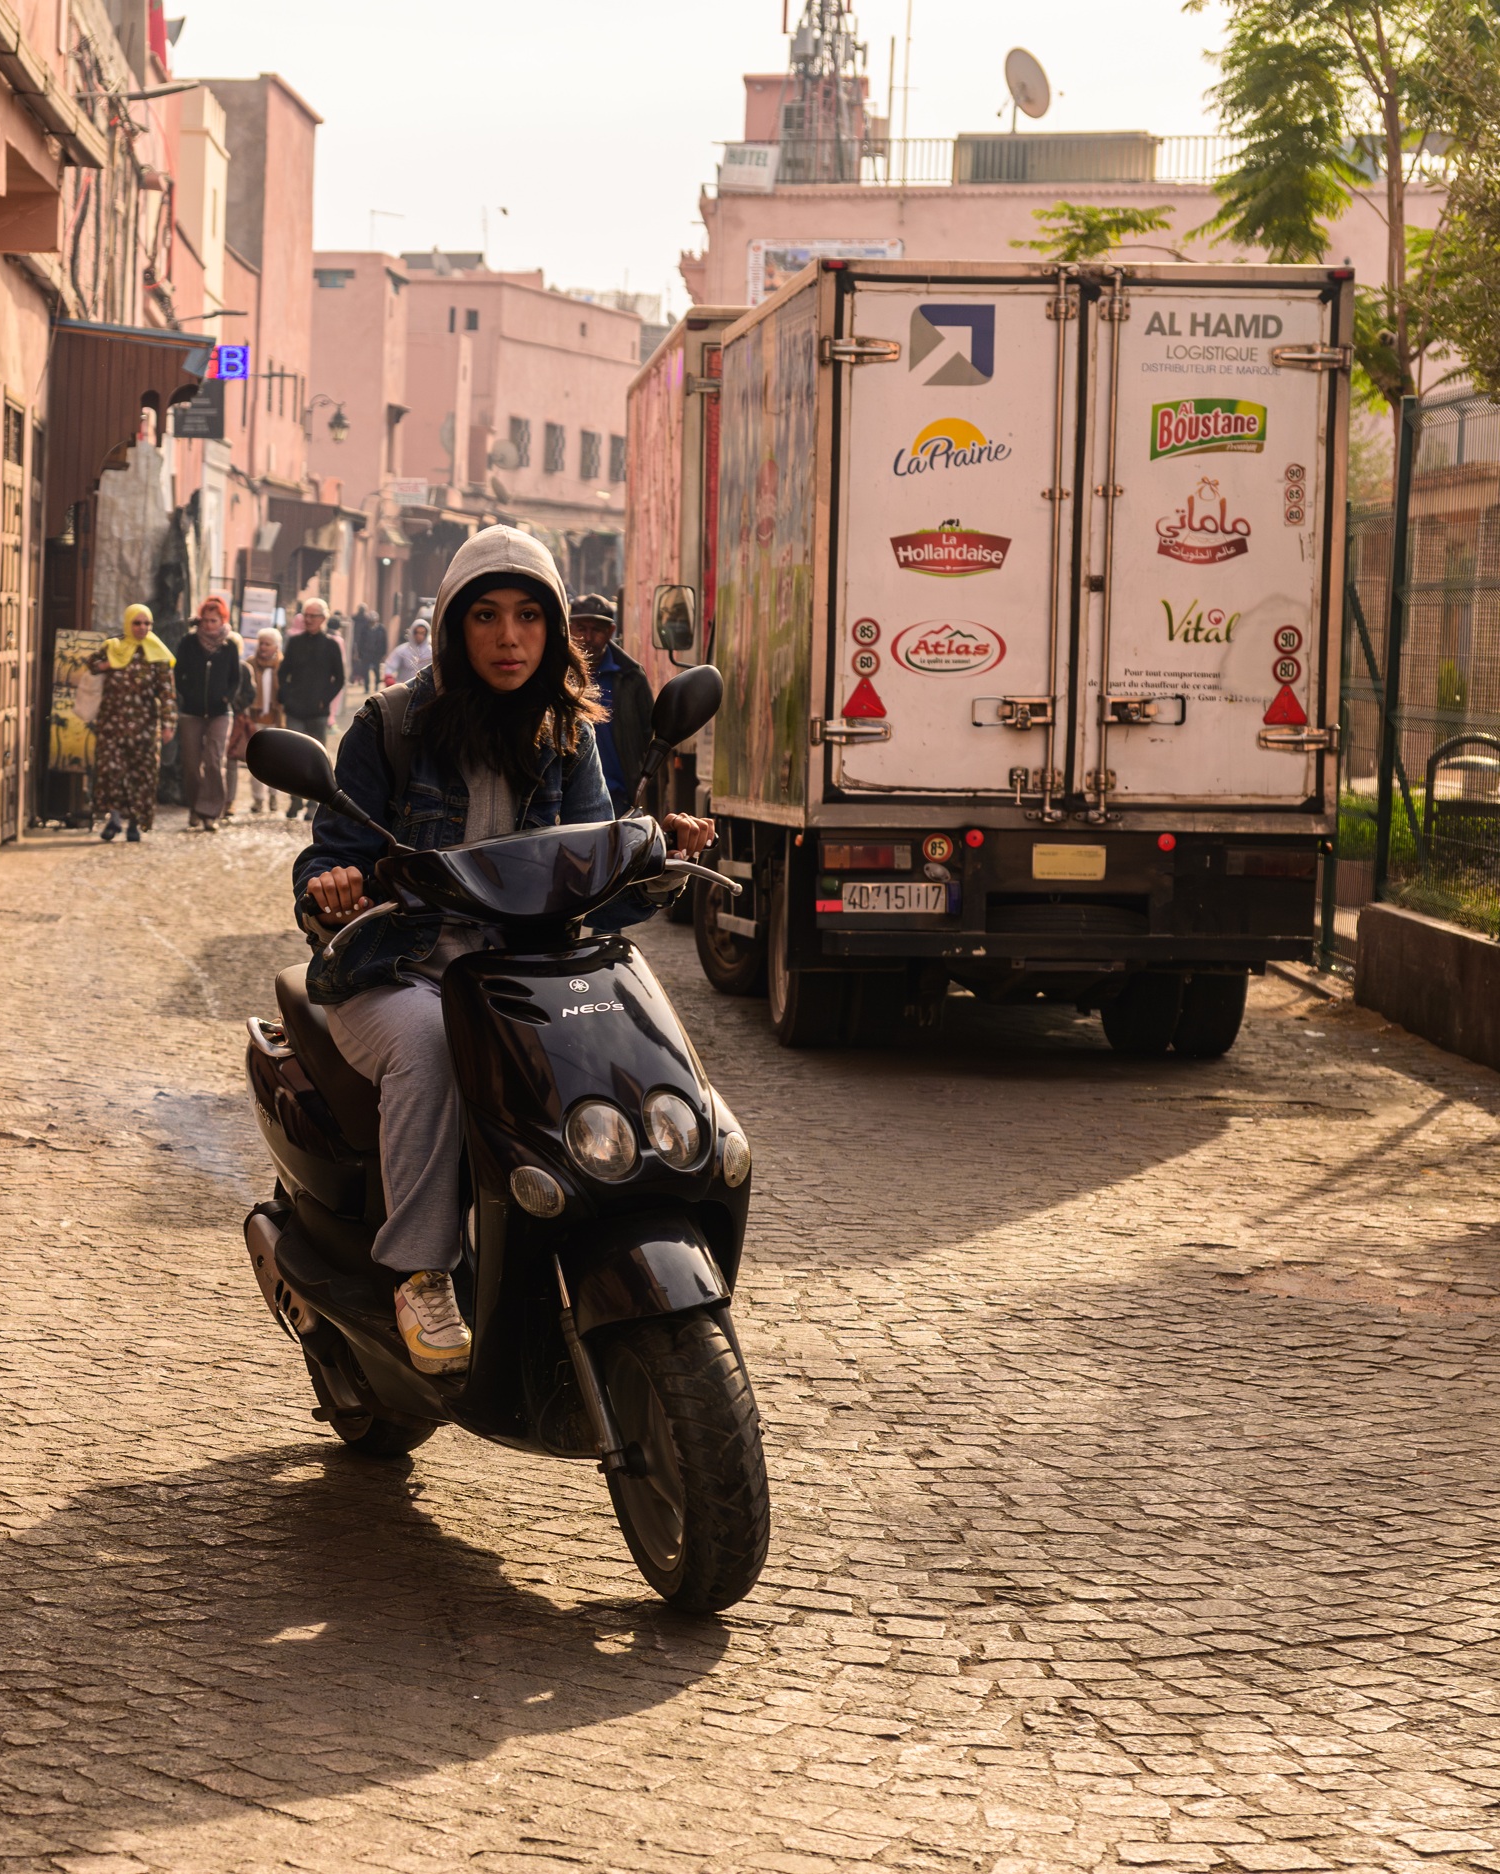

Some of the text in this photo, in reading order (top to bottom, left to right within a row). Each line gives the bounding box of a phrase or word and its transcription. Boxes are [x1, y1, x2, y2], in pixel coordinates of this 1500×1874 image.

[1144, 311, 1283, 339] AL HAMD
[1166, 345, 1258, 362] LOGISTIQUE
[1141, 363, 1281, 377] DISTRIBUTEUR DE MARQUE
[1157, 407, 1259, 451] Boustane
[893, 437, 1012, 477] La Prairie
[1289, 468, 1301, 479] 90
[1155, 495, 1252, 546] ماماتي
[942, 533, 957, 545] La
[897, 543, 1004, 564] Hollandaise
[1215, 545, 1237, 561] عالم
[1161, 599, 1242, 644] Vital
[859, 625, 874, 639] 85
[1280, 632, 1296, 648] 90
[909, 639, 991, 656] Atlas
[859, 655, 873, 669] 60
[1279, 662, 1295, 678] 80
[1124, 668, 1221, 680] Pour tout comportement
[1088, 679, 1098, 687] de
[1109, 680, 1126, 689] part
[1128, 680, 1139, 688] du
[1141, 680, 1178, 689] chauffeur
[1181, 681, 1191, 689] de
[1198, 693, 1217, 702] Gsm
[930, 840, 946, 857] 85
